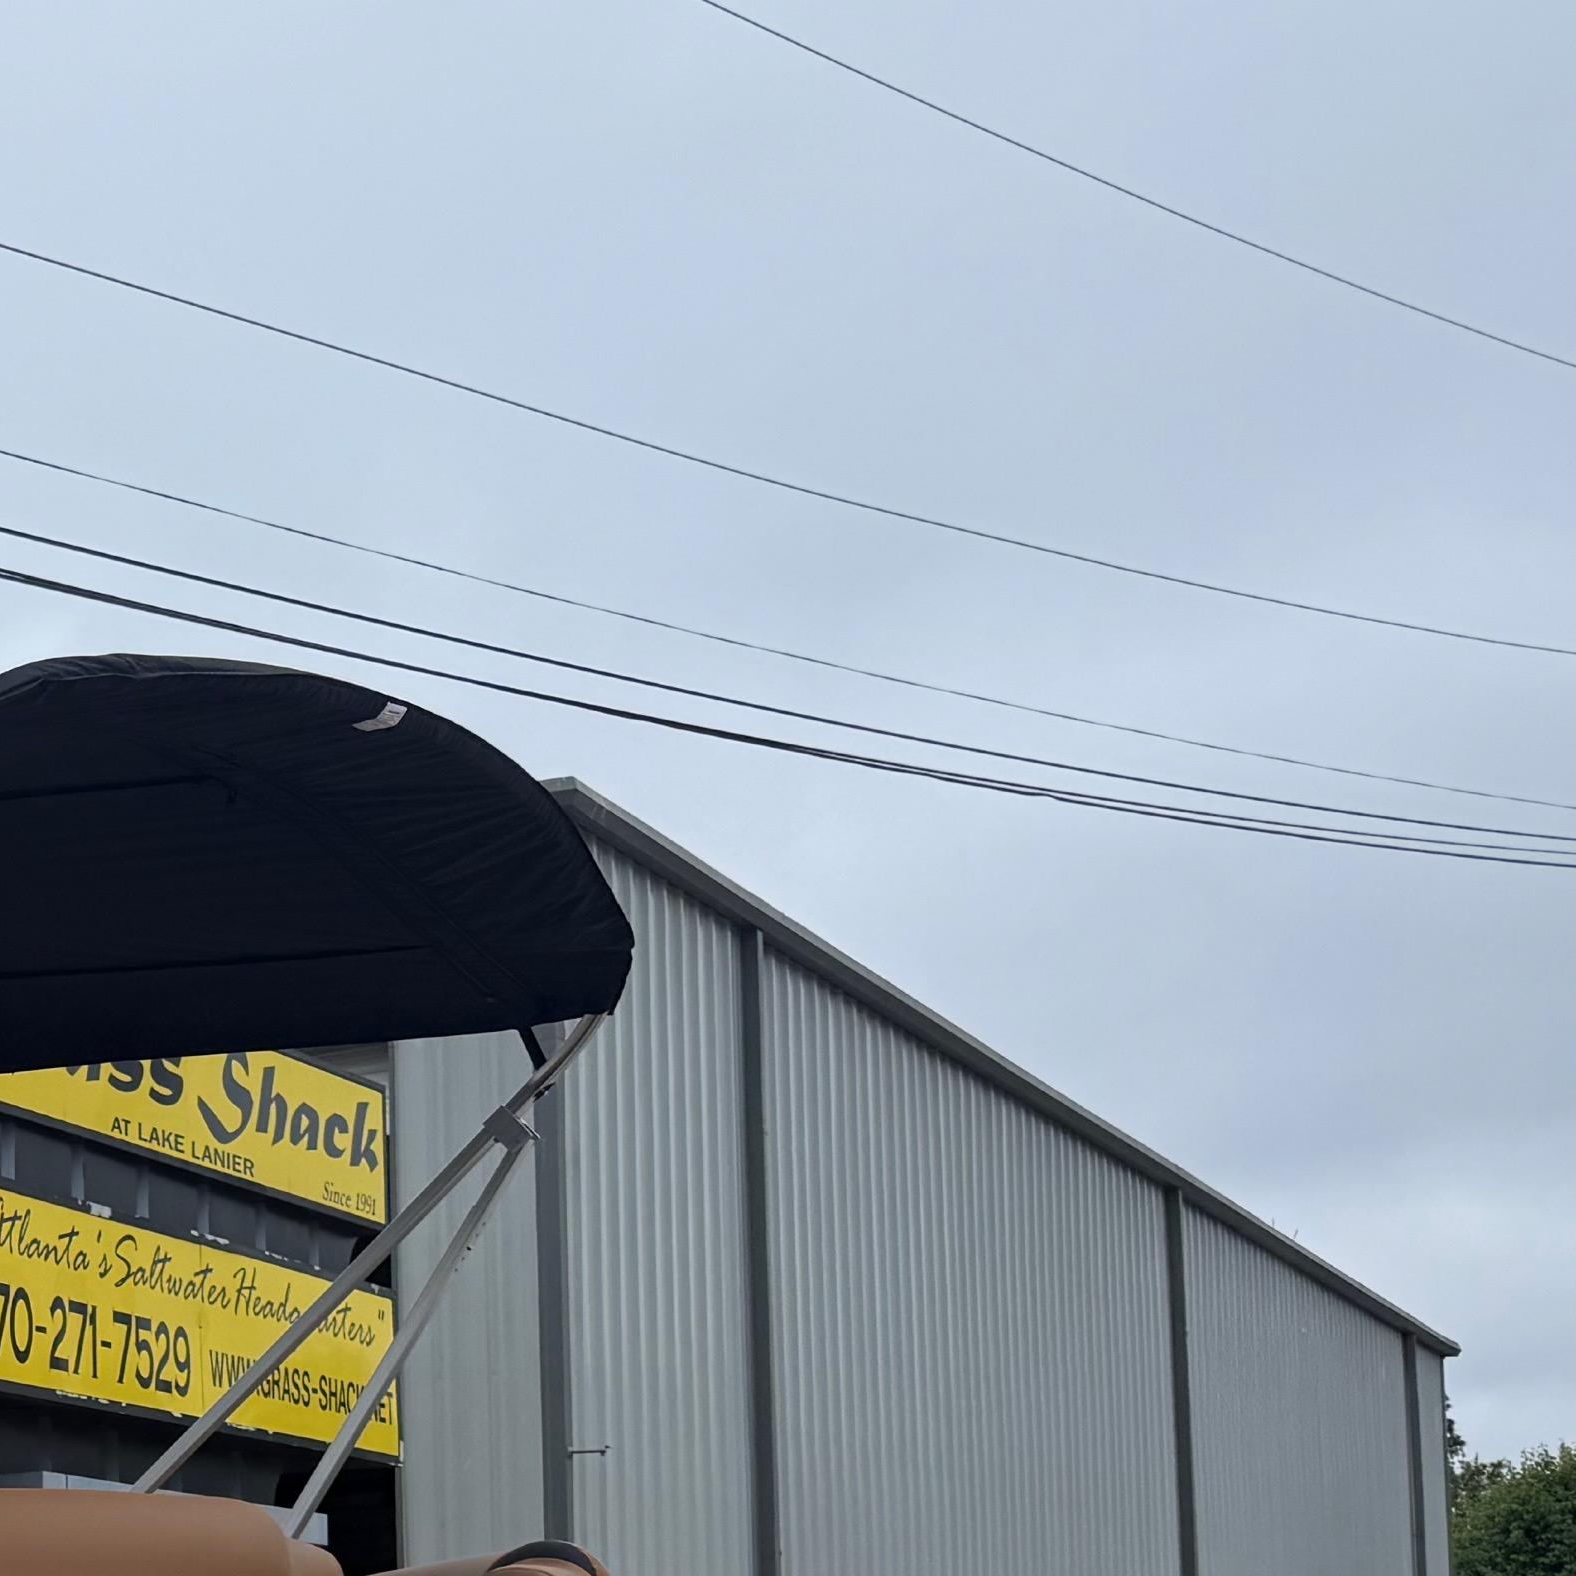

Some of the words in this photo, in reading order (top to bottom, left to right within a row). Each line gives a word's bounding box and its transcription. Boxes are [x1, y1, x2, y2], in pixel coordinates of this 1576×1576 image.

[110, 1117, 132, 1135] AT
[137, 1123, 185, 1154] LAKE
[191, 1141, 255, 1177] LANIER
[197, 1053, 379, 1173] Shack
[322, 1180, 352, 1209] Since
[355, 1192, 376, 1216] 1991
[114, 1233, 231, 1309] Saltwater
